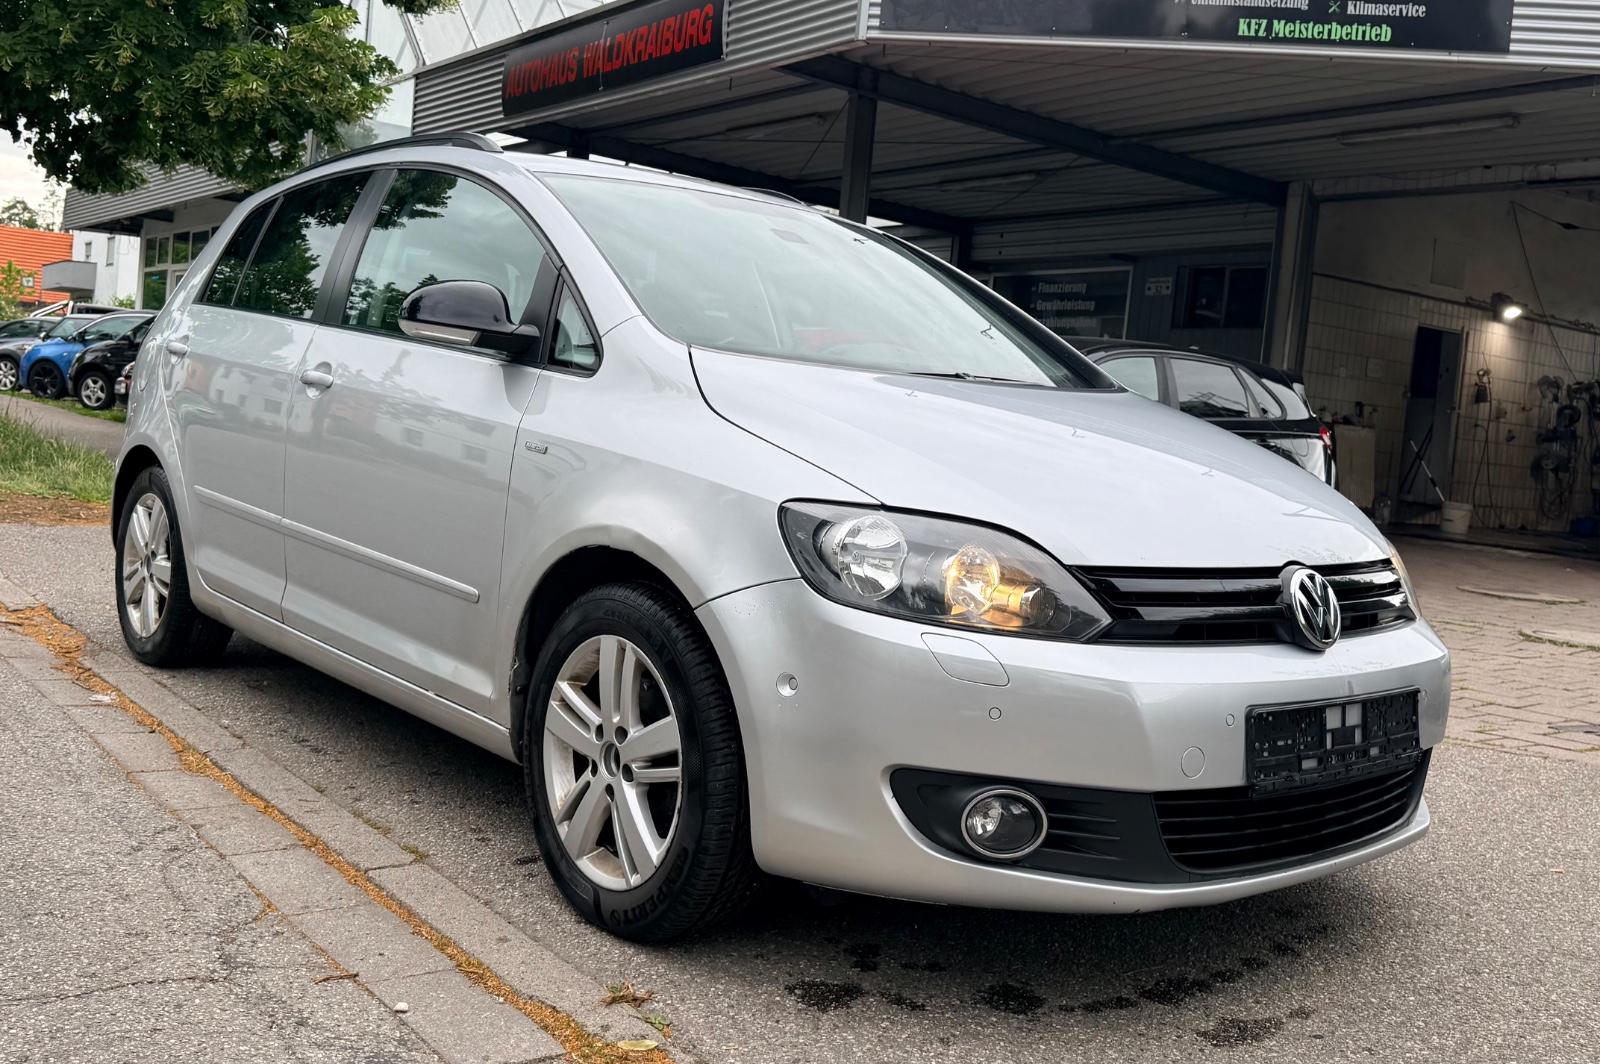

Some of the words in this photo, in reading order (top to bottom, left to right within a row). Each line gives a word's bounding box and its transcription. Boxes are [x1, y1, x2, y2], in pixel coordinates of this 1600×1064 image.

[1346, 0, 1427, 18] Klimaservice
[1237, 18, 1268, 37] KFZ
[1272, 19, 1392, 42] Meisterbetrieb
[505, 47, 580, 99] AUTOHAUS
[582, 3, 714, 79] WALDKRAIBURG
